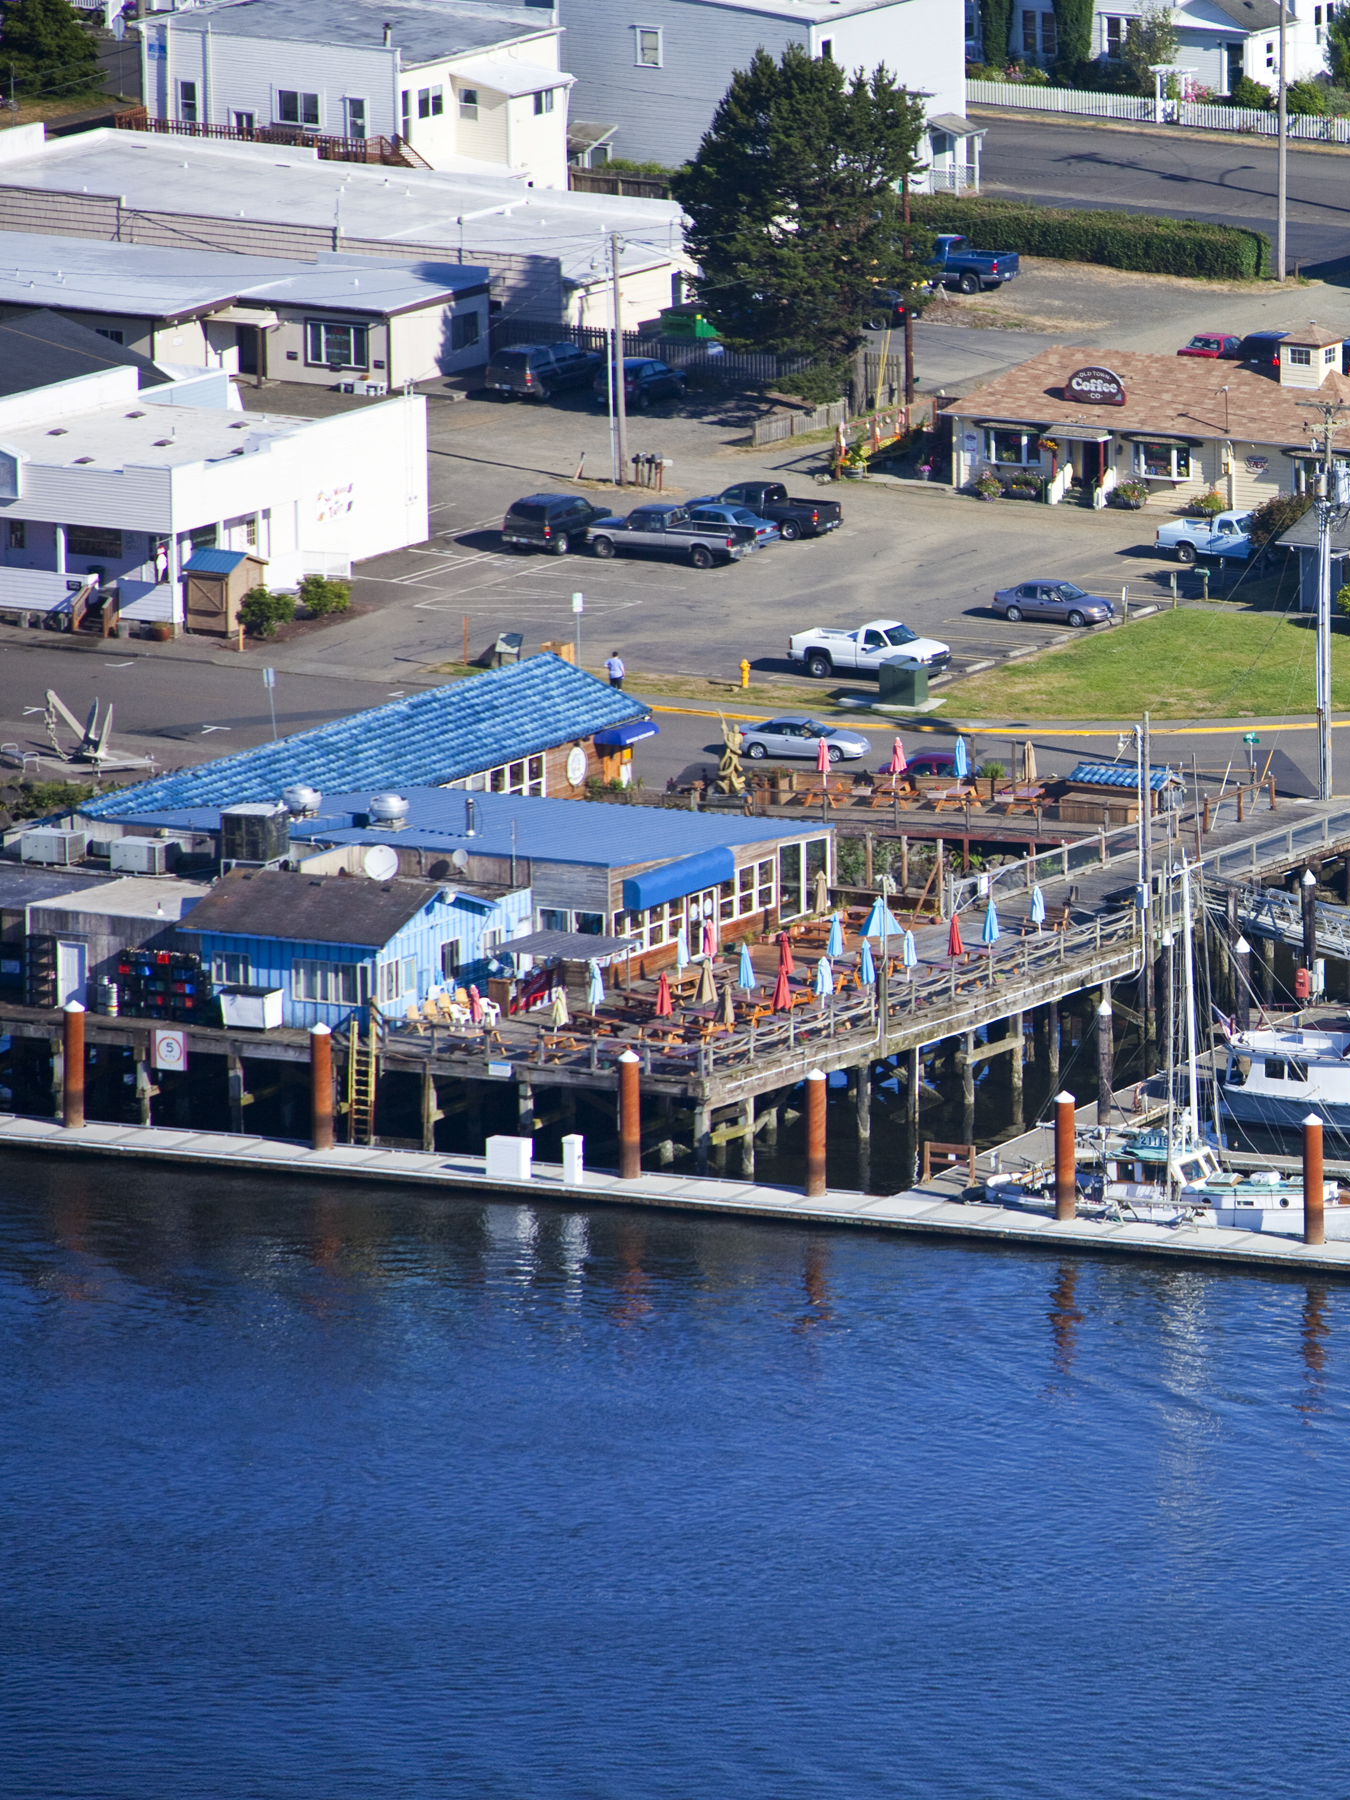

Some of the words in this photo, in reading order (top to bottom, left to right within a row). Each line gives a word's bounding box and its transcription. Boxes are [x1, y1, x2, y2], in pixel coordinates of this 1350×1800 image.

[1092, 371, 1110, 380] TOWN
[1071, 377, 1118, 393] Coffee
[166, 1042, 174, 1053] 5
